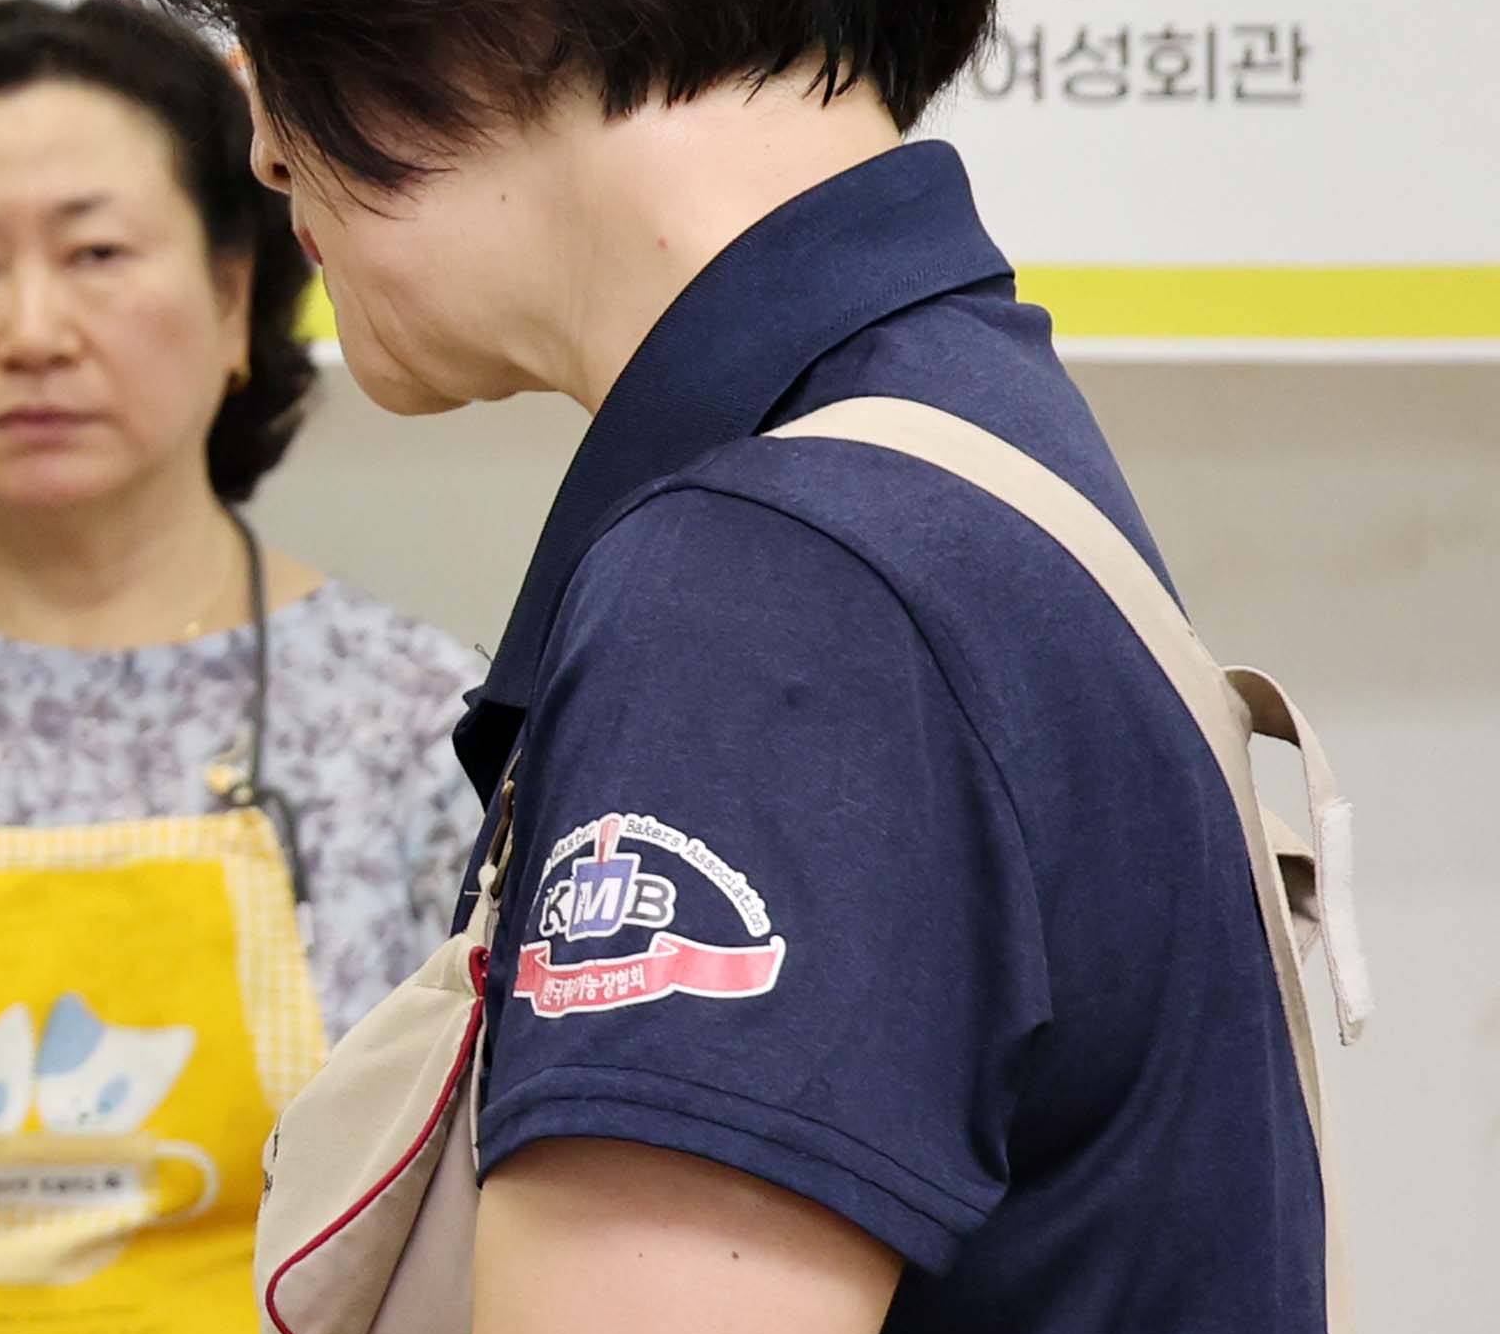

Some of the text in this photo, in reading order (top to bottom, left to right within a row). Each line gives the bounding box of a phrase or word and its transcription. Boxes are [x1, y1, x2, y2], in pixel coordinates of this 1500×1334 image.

[974, 24, 1312, 104] 여성회관
[542, 877, 671, 931] KMB
[625, 818, 682, 849] Bakers
[686, 843, 765, 931] Association
